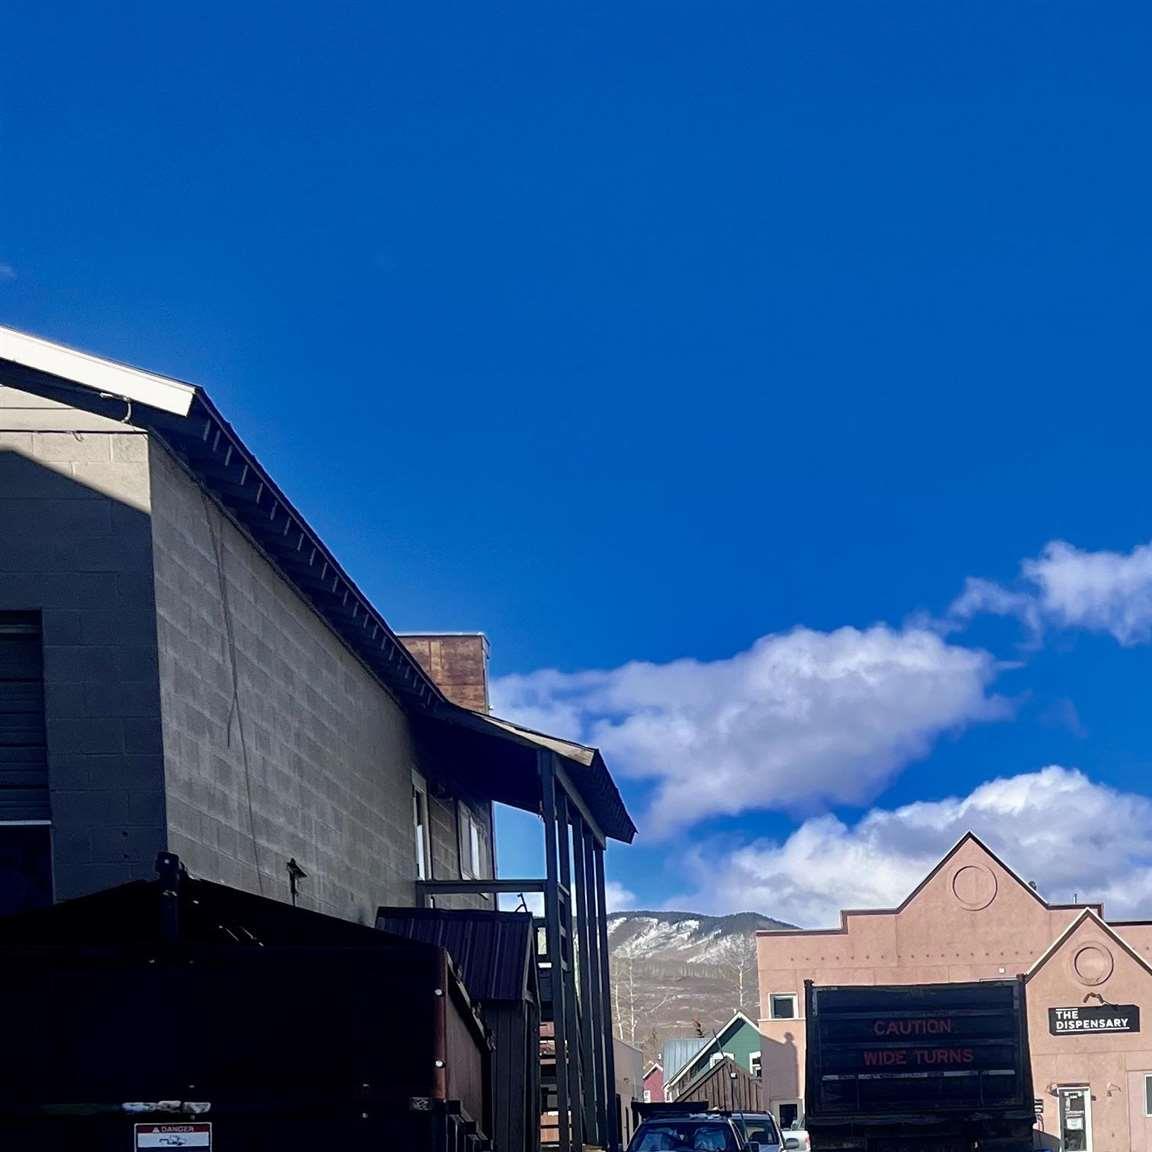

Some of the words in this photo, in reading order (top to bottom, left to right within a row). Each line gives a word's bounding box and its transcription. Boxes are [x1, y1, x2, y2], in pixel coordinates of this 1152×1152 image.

[1056, 1011, 1078, 1019] THE
[873, 1018, 951, 1035] CAUTION
[1056, 1018, 1129, 1029] DISPENSARY
[864, 1050, 907, 1066] WIDE
[915, 1048, 975, 1065] TURNS
